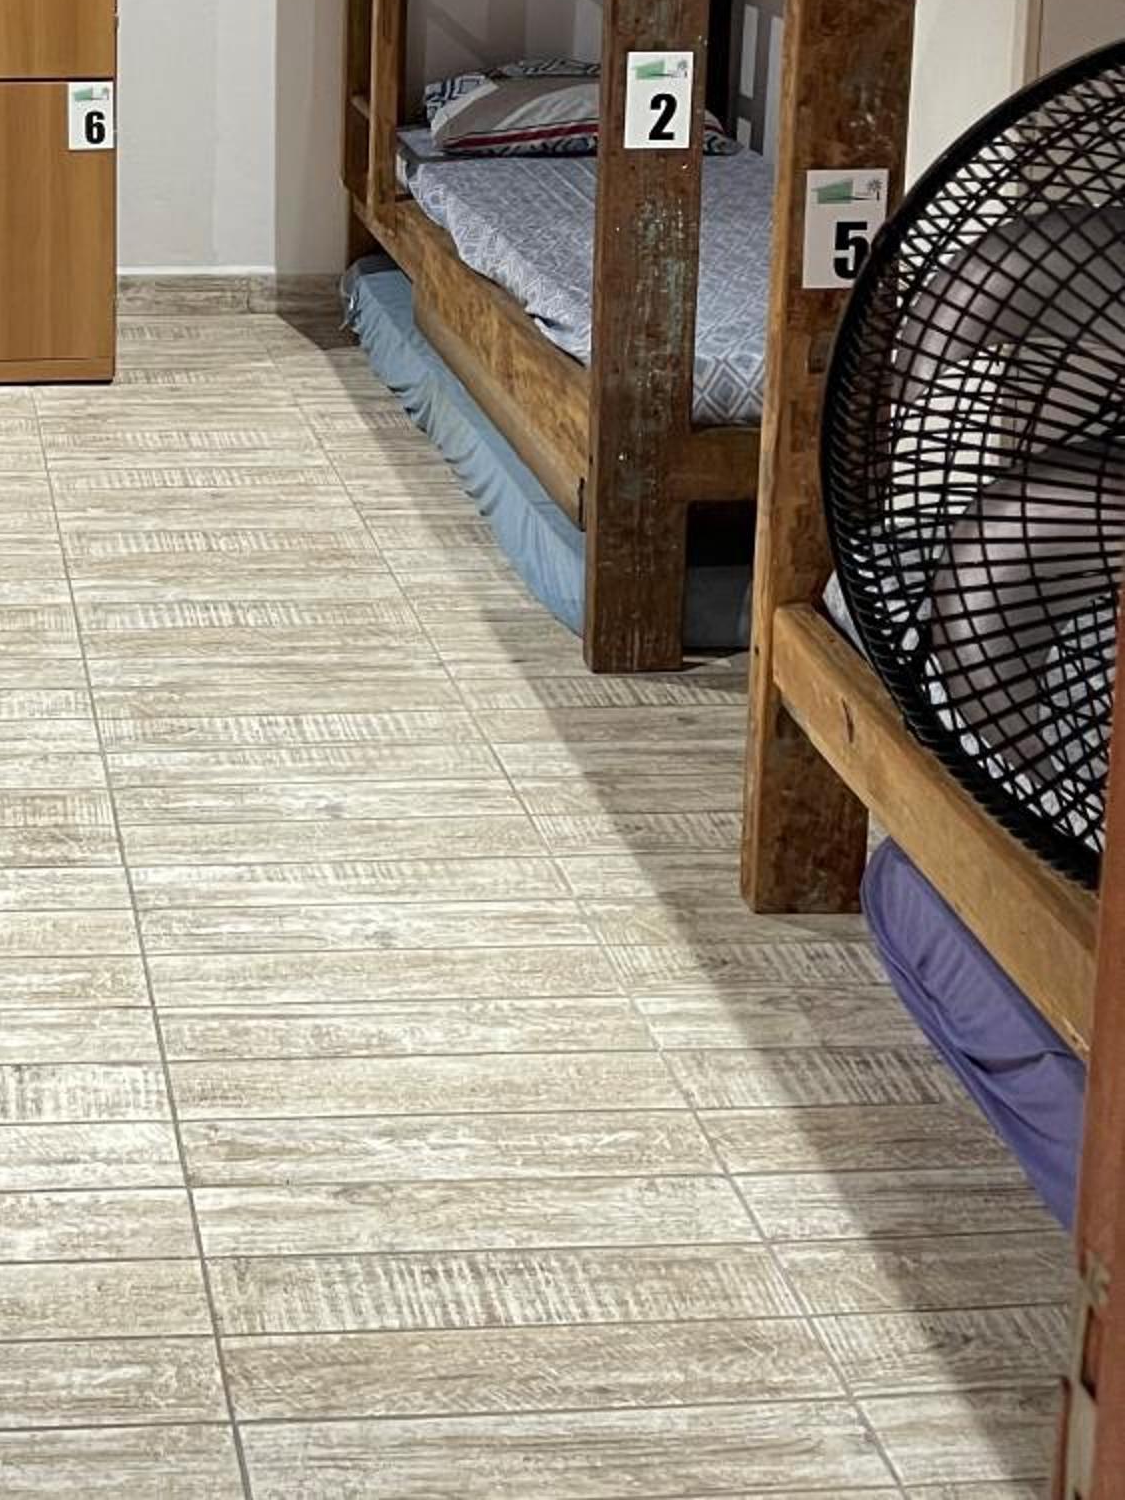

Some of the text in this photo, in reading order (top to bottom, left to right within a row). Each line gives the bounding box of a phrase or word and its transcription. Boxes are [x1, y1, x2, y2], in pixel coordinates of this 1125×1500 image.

[85, 111, 106, 145] 6
[648, 93, 677, 141] 2
[833, 220, 870, 279] 5
